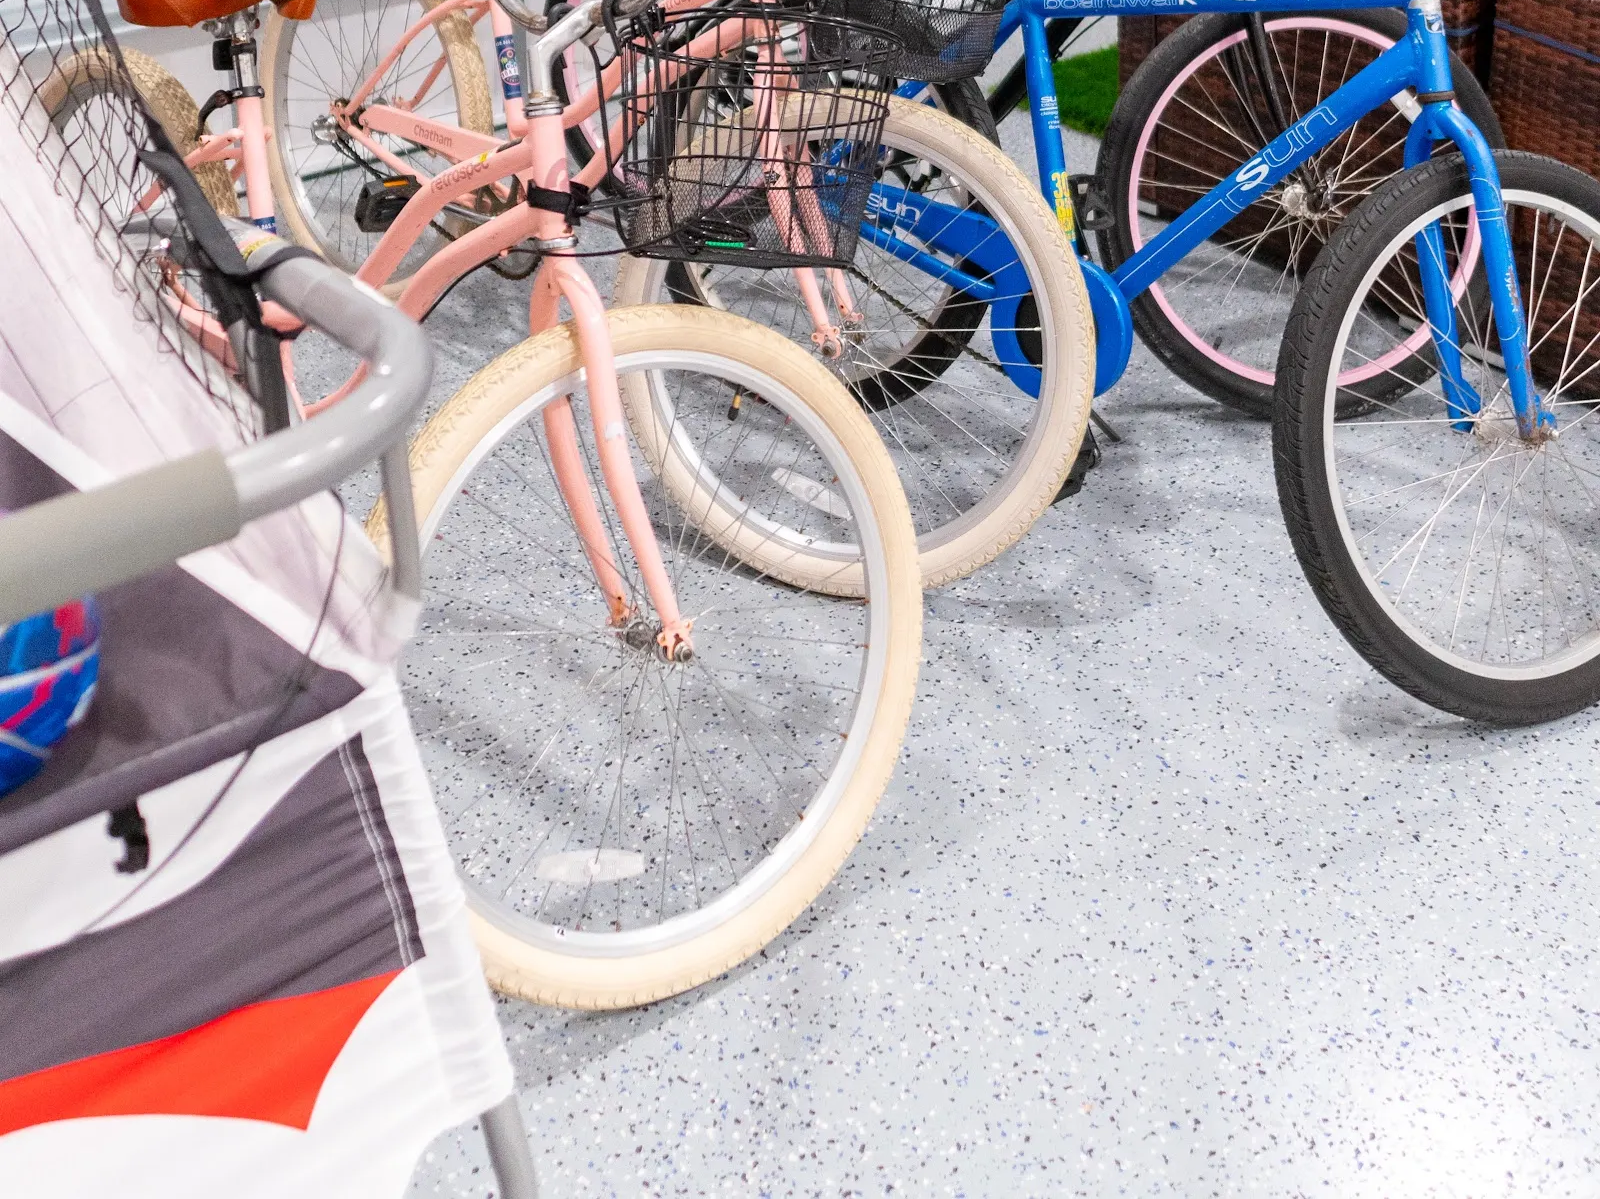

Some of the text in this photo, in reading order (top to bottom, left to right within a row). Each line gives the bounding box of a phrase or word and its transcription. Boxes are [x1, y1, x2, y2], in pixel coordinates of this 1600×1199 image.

[413, 124, 453, 147] Chatham
[1235, 106, 1338, 191] sun
[431, 161, 490, 193] retrospec
[866, 193, 921, 222] sun
